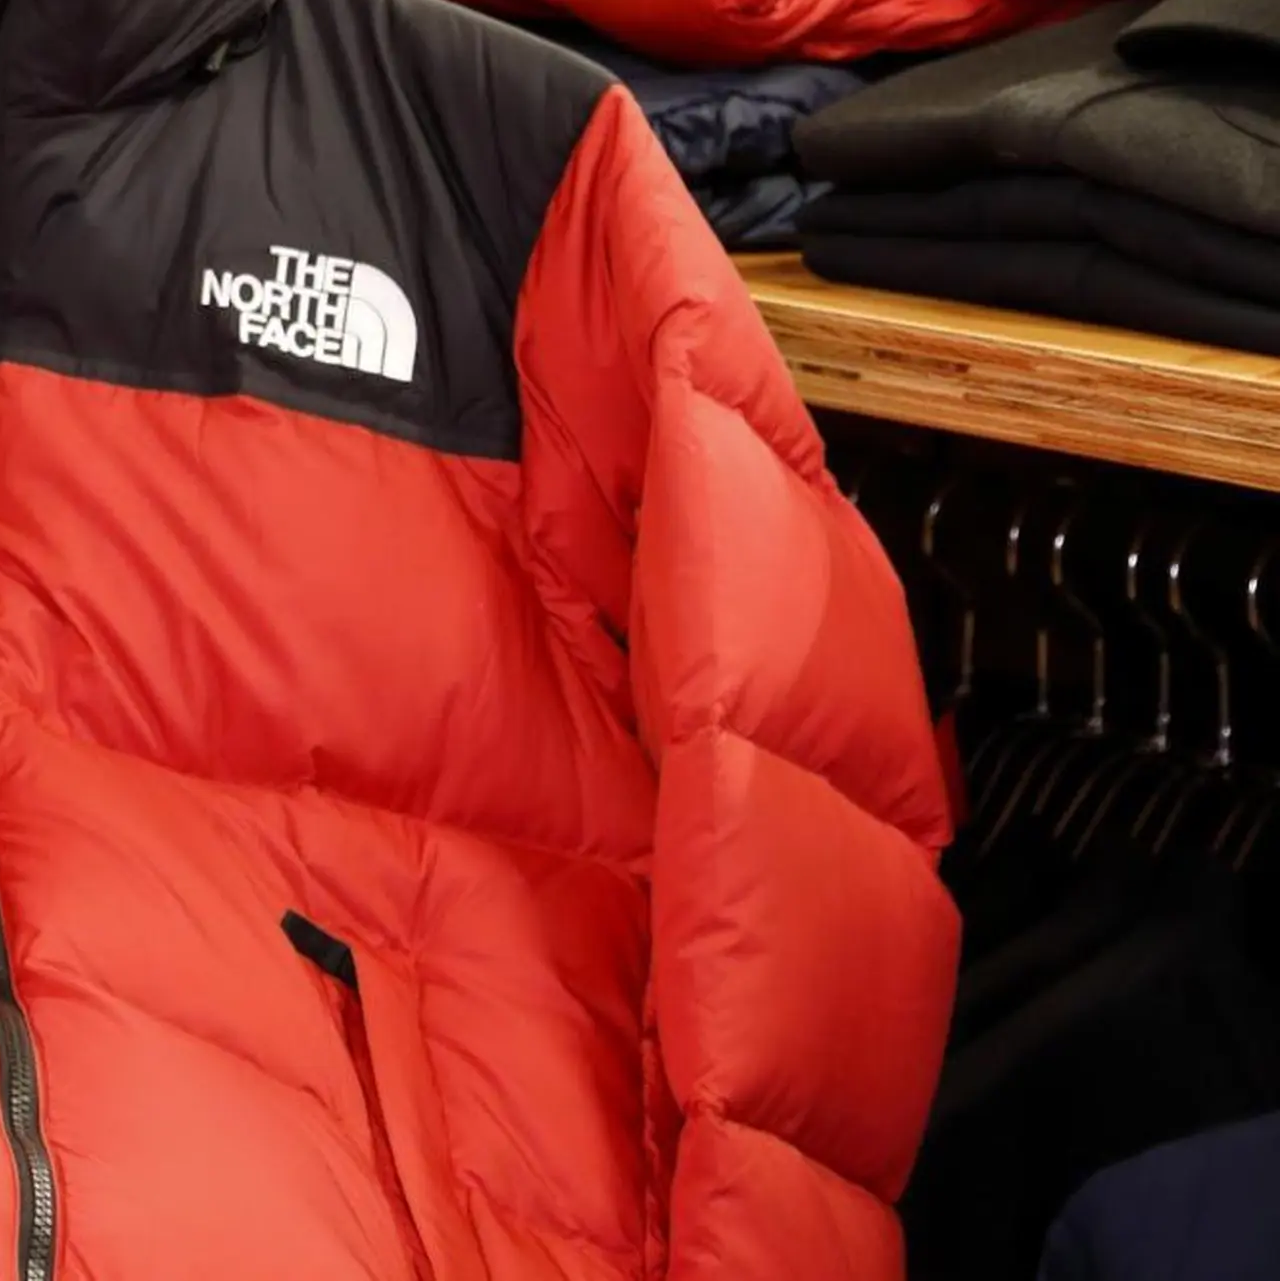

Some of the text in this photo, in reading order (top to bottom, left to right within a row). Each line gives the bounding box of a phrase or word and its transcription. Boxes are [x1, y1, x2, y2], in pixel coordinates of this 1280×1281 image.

[269, 245, 355, 296] THE
[201, 269, 349, 334] NORTH
[239, 311, 344, 365] FACE
